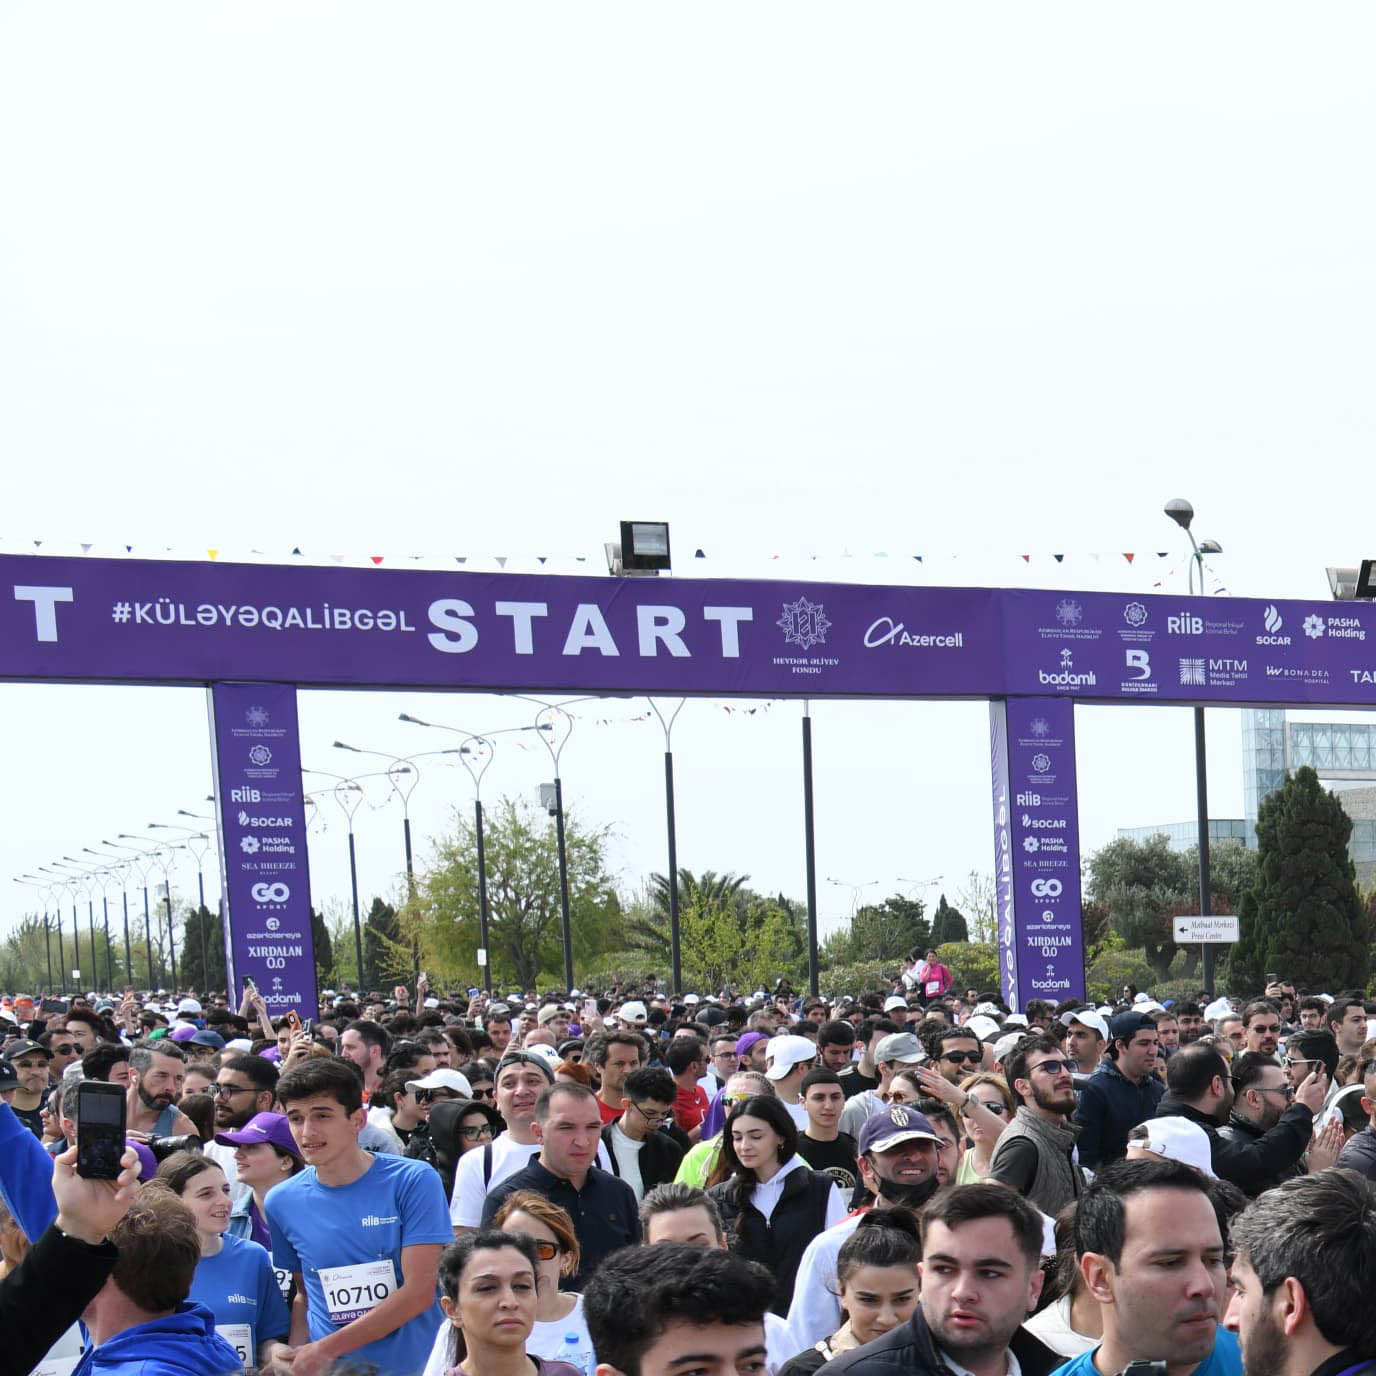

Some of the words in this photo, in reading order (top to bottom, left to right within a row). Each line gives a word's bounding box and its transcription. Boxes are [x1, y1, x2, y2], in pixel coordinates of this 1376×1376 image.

[111, 596, 416, 633] #KÜLƏYƏQALİBGƏL
[427, 598, 754, 658] START
[1328, 618, 1360, 627] PASHA
[899, 631, 963, 648] Azercell
[1328, 628, 1366, 640] Holding
[1256, 636, 1291, 645] SOCAR
[773, 657, 808, 665] HEYDƏR
[1209, 659, 1248, 671] MTM
[792, 666, 822, 674] FONDU
[250, 817, 293, 827] SOCAR
[1031, 819, 1067, 828] SOCAR
[262, 837, 291, 845] PASHA
[1041, 837, 1064, 845] PASHA
[262, 844, 295, 854] Holding
[1041, 844, 1068, 853] Holding
[251, 882, 290, 903] GO
[1031, 878, 1063, 897] GO
[248, 946, 302, 958] XIRDALAN
[263, 992, 301, 1004] adamlı
[329, 1283, 389, 1306] 10710
